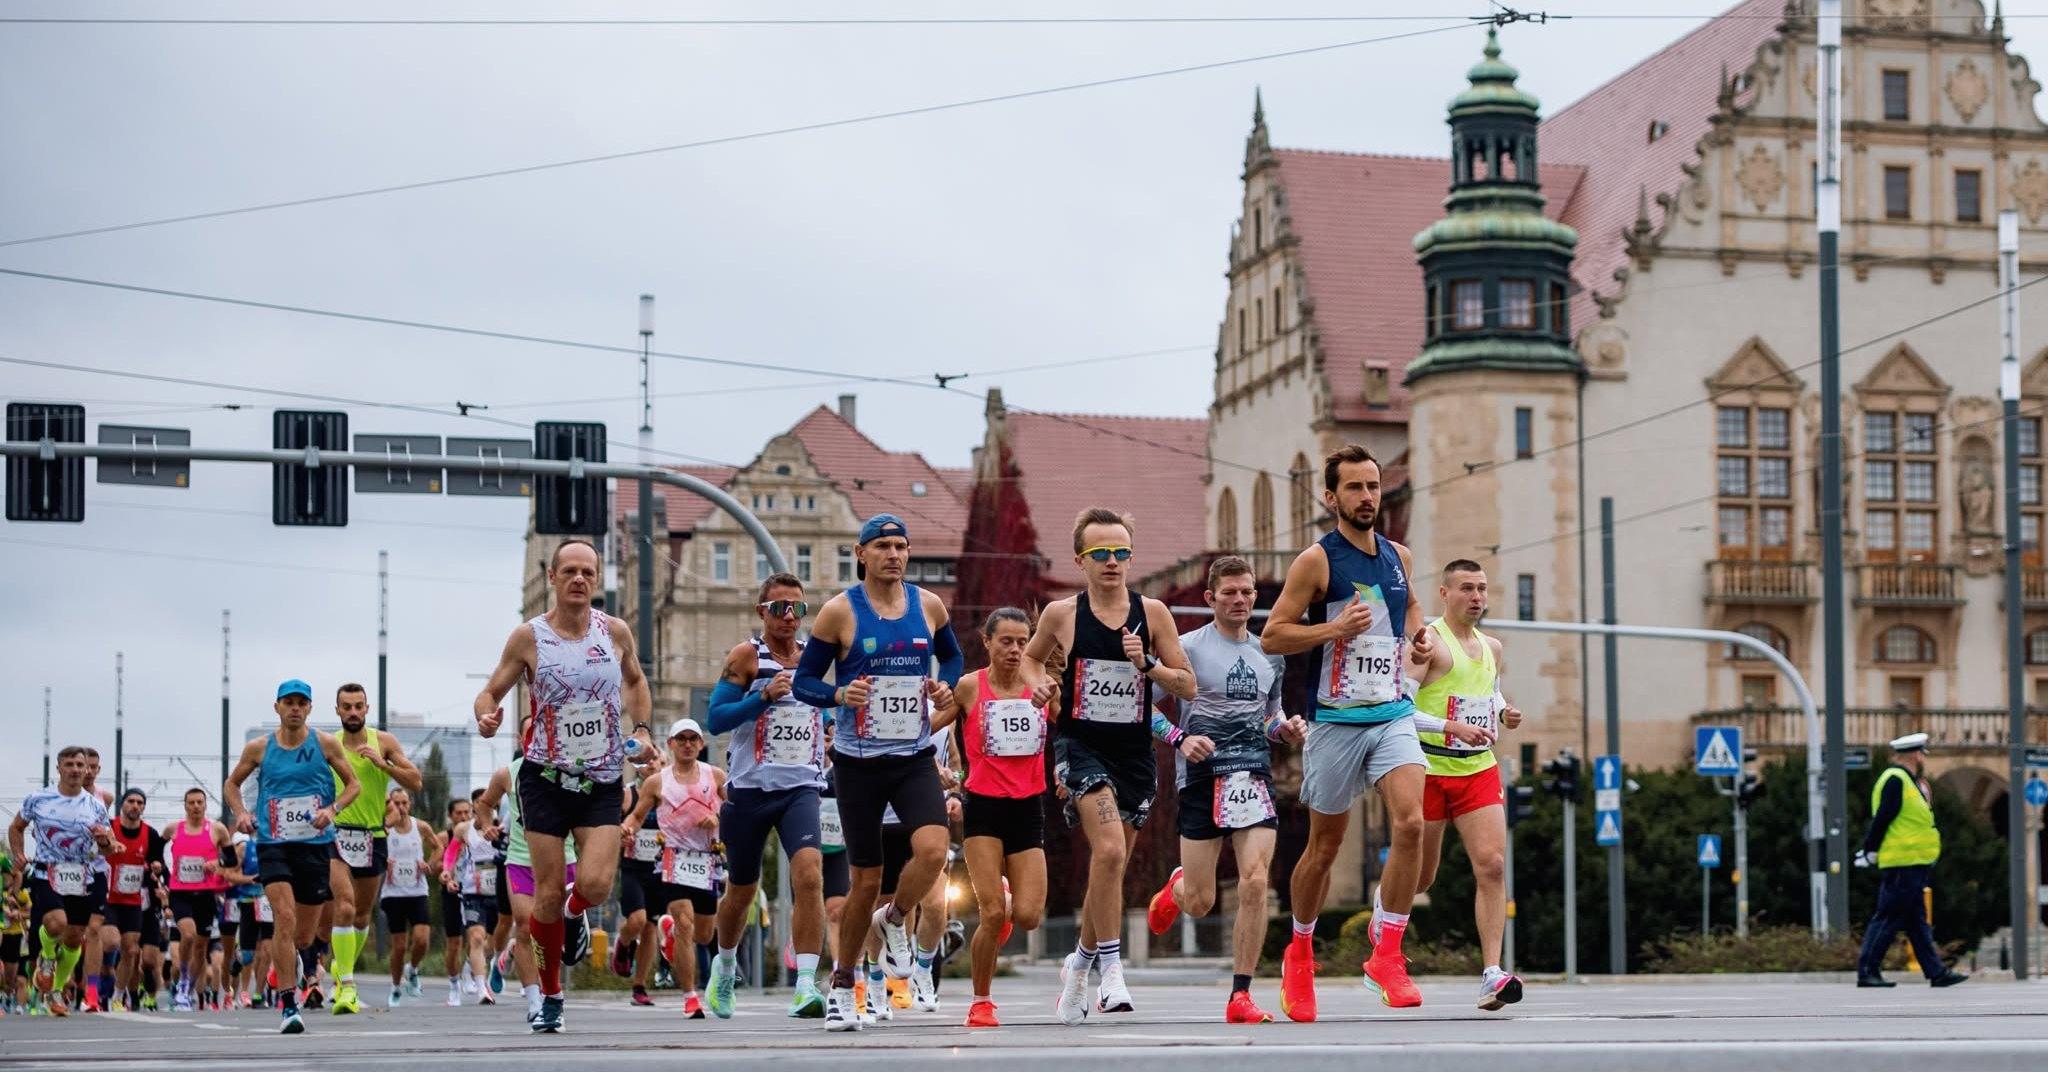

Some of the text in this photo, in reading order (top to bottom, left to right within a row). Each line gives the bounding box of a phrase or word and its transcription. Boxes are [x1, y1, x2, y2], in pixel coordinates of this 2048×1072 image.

[870, 656, 921, 668] WITKOWO
[1356, 656, 1391, 675] 1195
[1227, 677, 1257, 686] JACEK
[1089, 680, 1136, 698] 2644
[1227, 685, 1257, 694] BIEGA
[880, 697, 918, 713] 1312
[1001, 717, 1030, 732] 158
[1465, 715, 1488, 728] 1922
[564, 719, 602, 738] 1081
[772, 725, 811, 741] 2366
[639, 839, 658, 849] 105
[680, 862, 706, 875] 4155
[58, 871, 82, 882] 1706
